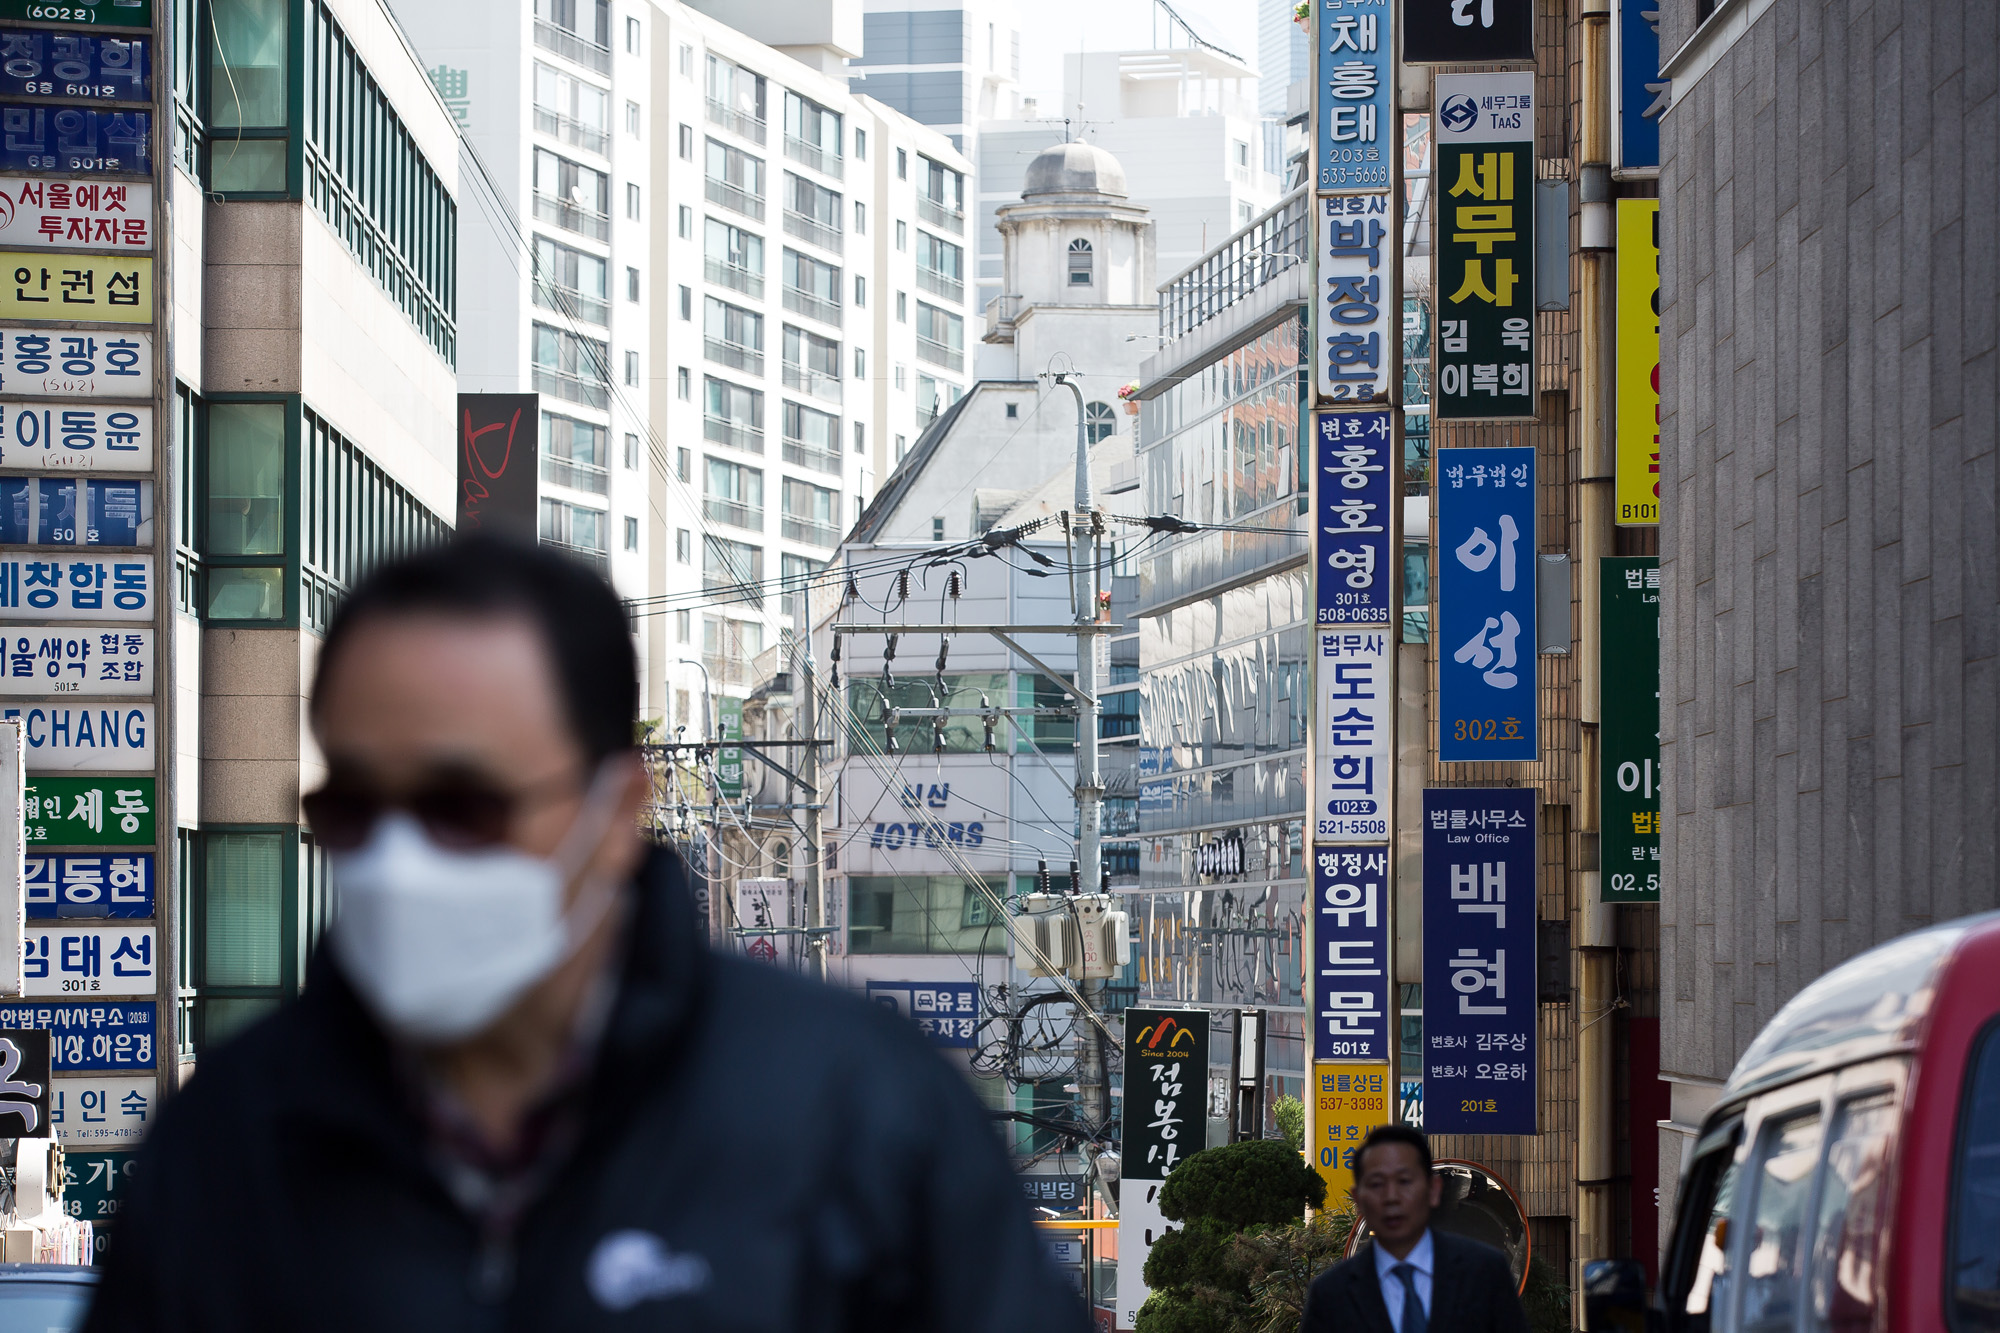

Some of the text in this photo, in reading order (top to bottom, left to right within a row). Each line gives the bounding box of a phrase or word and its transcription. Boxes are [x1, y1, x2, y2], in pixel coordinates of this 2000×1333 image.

[26, 5, 95, 23] (602호)
[0, 33, 142, 84] 정광희
[1328, 13, 1379, 142] 채홍태
[25, 81, 116, 98] 6층 601호
[1481, 95, 1531, 110] 세무그룹
[3, 108, 146, 157] 민인식
[28, 155, 120, 171] 6층 601호
[1329, 147, 1380, 163] 203호
[1322, 165, 1387, 184] 533-5668
[18, 182, 127, 212] 서울에셋
[1326, 195, 1387, 216] 변호사
[38, 216, 147, 245] 투자자문
[1448, 152, 1519, 307] 세무사
[14, 267, 139, 306] 안권섭
[1326, 219, 1386, 381] 박정현
[15, 334, 141, 376] 홍광호
[43, 378, 95, 393] (502)
[1441, 363, 1530, 397] 이복희
[1333, 383, 1375, 401] 2층
[16, 410, 141, 451] 이동윤
[1321, 416, 1390, 441] 변호사
[1446, 463, 1528, 488] 법무법인
[1323, 445, 1384, 588] 홍호영
[1622, 503, 1657, 519] B101
[53, 528, 99, 542] 50호
[1335, 592, 1371, 605] 301호
[1454, 514, 1521, 689] 이선
[1318, 607, 1388, 622] 508-0635
[100, 633, 144, 655] 협동
[1322, 634, 1384, 657] 법무사
[100, 660, 144, 682] 조합
[54, 682, 79, 692] 501호
[1331, 663, 1375, 795] 도순희
[1454, 716, 1525, 741] 302호
[67, 788, 150, 834] 세동
[1334, 800, 1370, 814] 102호
[1318, 820, 1386, 834] 521-5508
[1430, 809, 1527, 830] 법률사무소
[1447, 833, 1510, 843] Law Office
[1318, 853, 1387, 877] 행정사
[25, 857, 146, 903] 김동현
[1611, 873, 1660, 891] 02.5
[1449, 861, 1507, 1015] 백현
[1321, 883, 1381, 1035] 위드문
[62, 980, 101, 992] 301호
[936, 992, 974, 1012] 유료
[128, 1011, 150, 1024] (203호)
[1332, 1041, 1371, 1055] 501호
[1431, 1033, 1527, 1051] 변호사 김주상
[1141, 1049, 1189, 1058] Since 2004
[1431, 1063, 1527, 1081] 변호사 오윤하
[1321, 1074, 1384, 1093] 법률상담
[1320, 1097, 1383, 1111] 537-3393
[1461, 1099, 1498, 1113] 201호
[77, 1130, 92, 1138] Tel:
